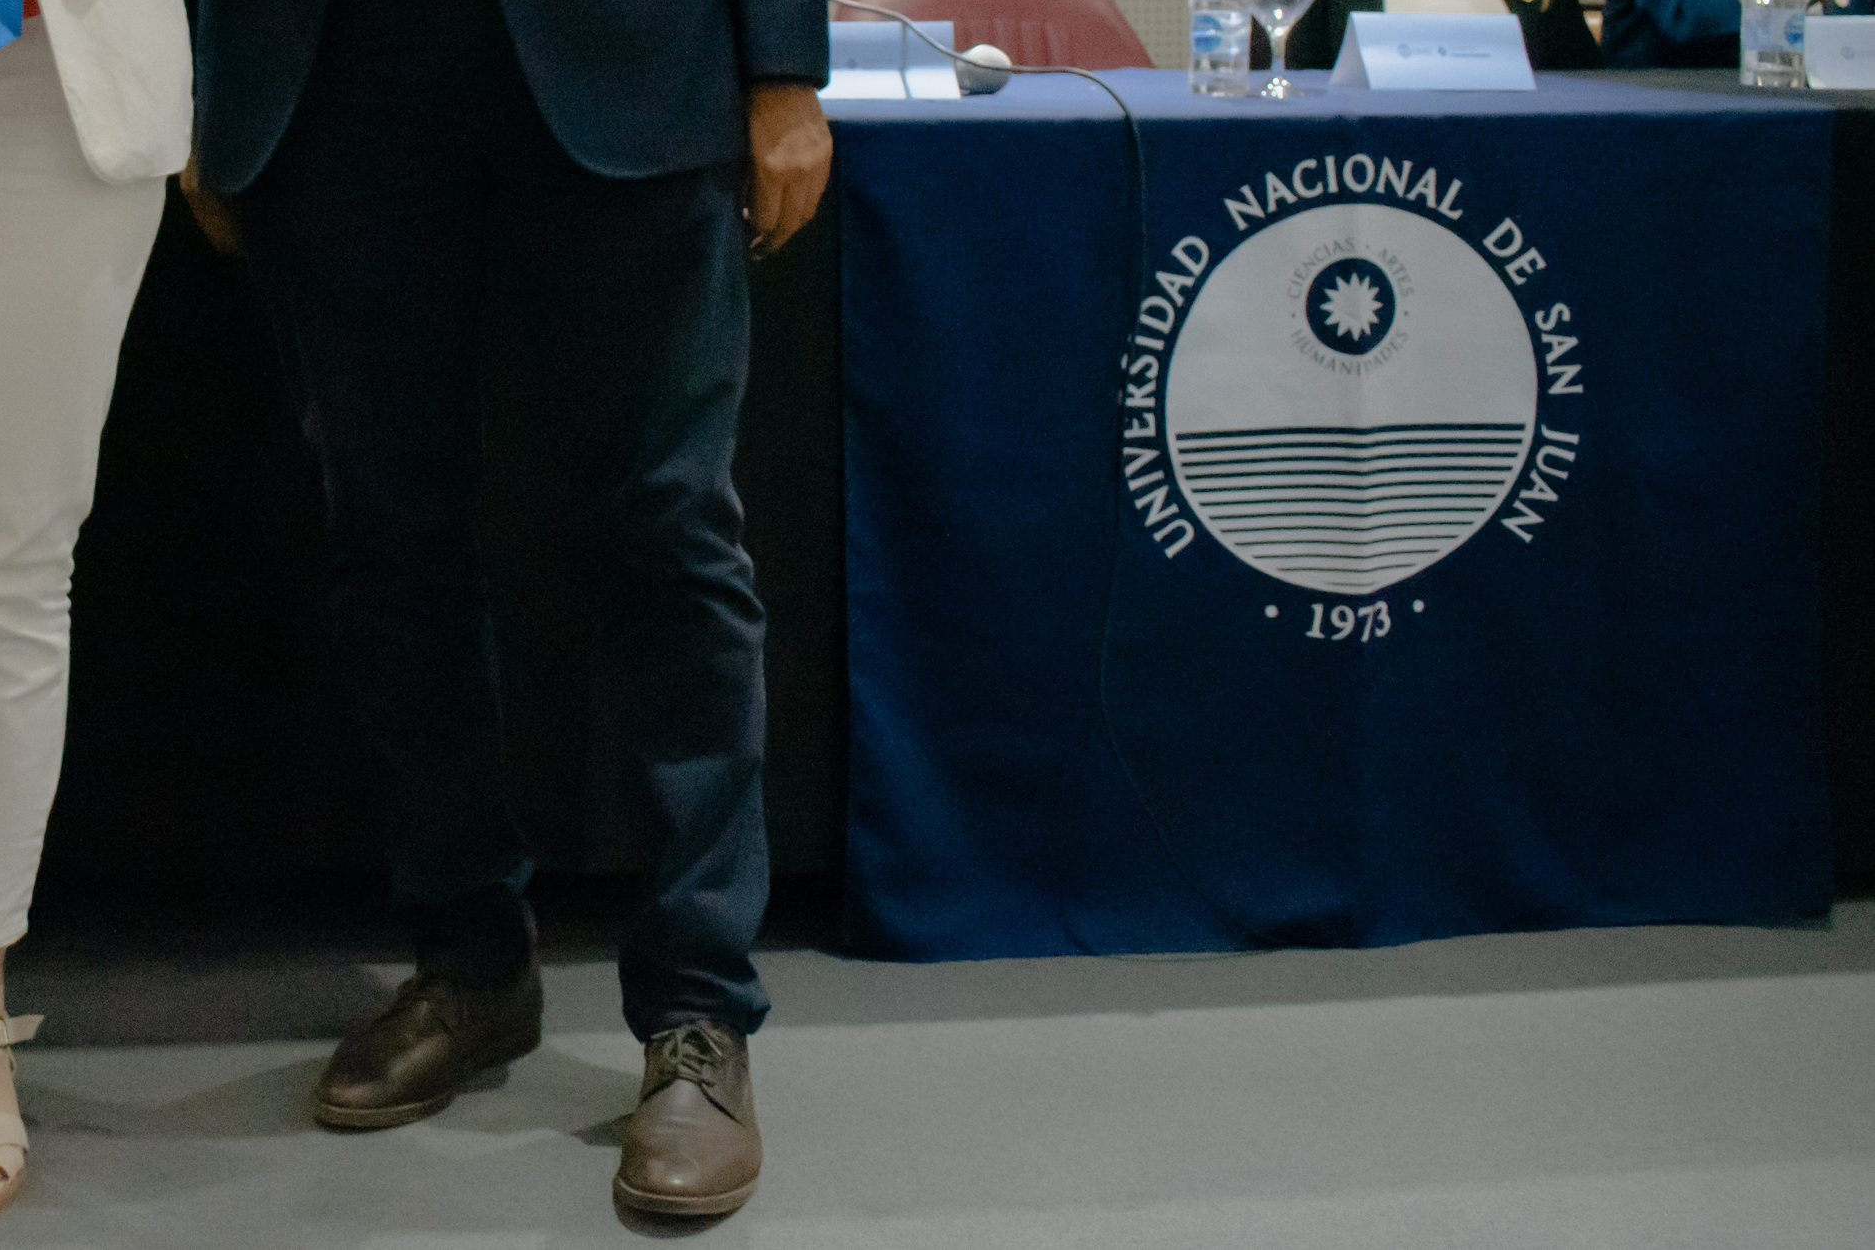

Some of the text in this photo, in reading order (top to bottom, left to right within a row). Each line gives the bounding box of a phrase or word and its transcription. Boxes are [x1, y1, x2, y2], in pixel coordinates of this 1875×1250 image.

[1286, 236, 1417, 300] CIENCIAS ARTES
[1119, 152, 1585, 559] UNIVERSIDAD NACIONAL DE SAN JUAN
[1304, 599, 1392, 644] 1973
